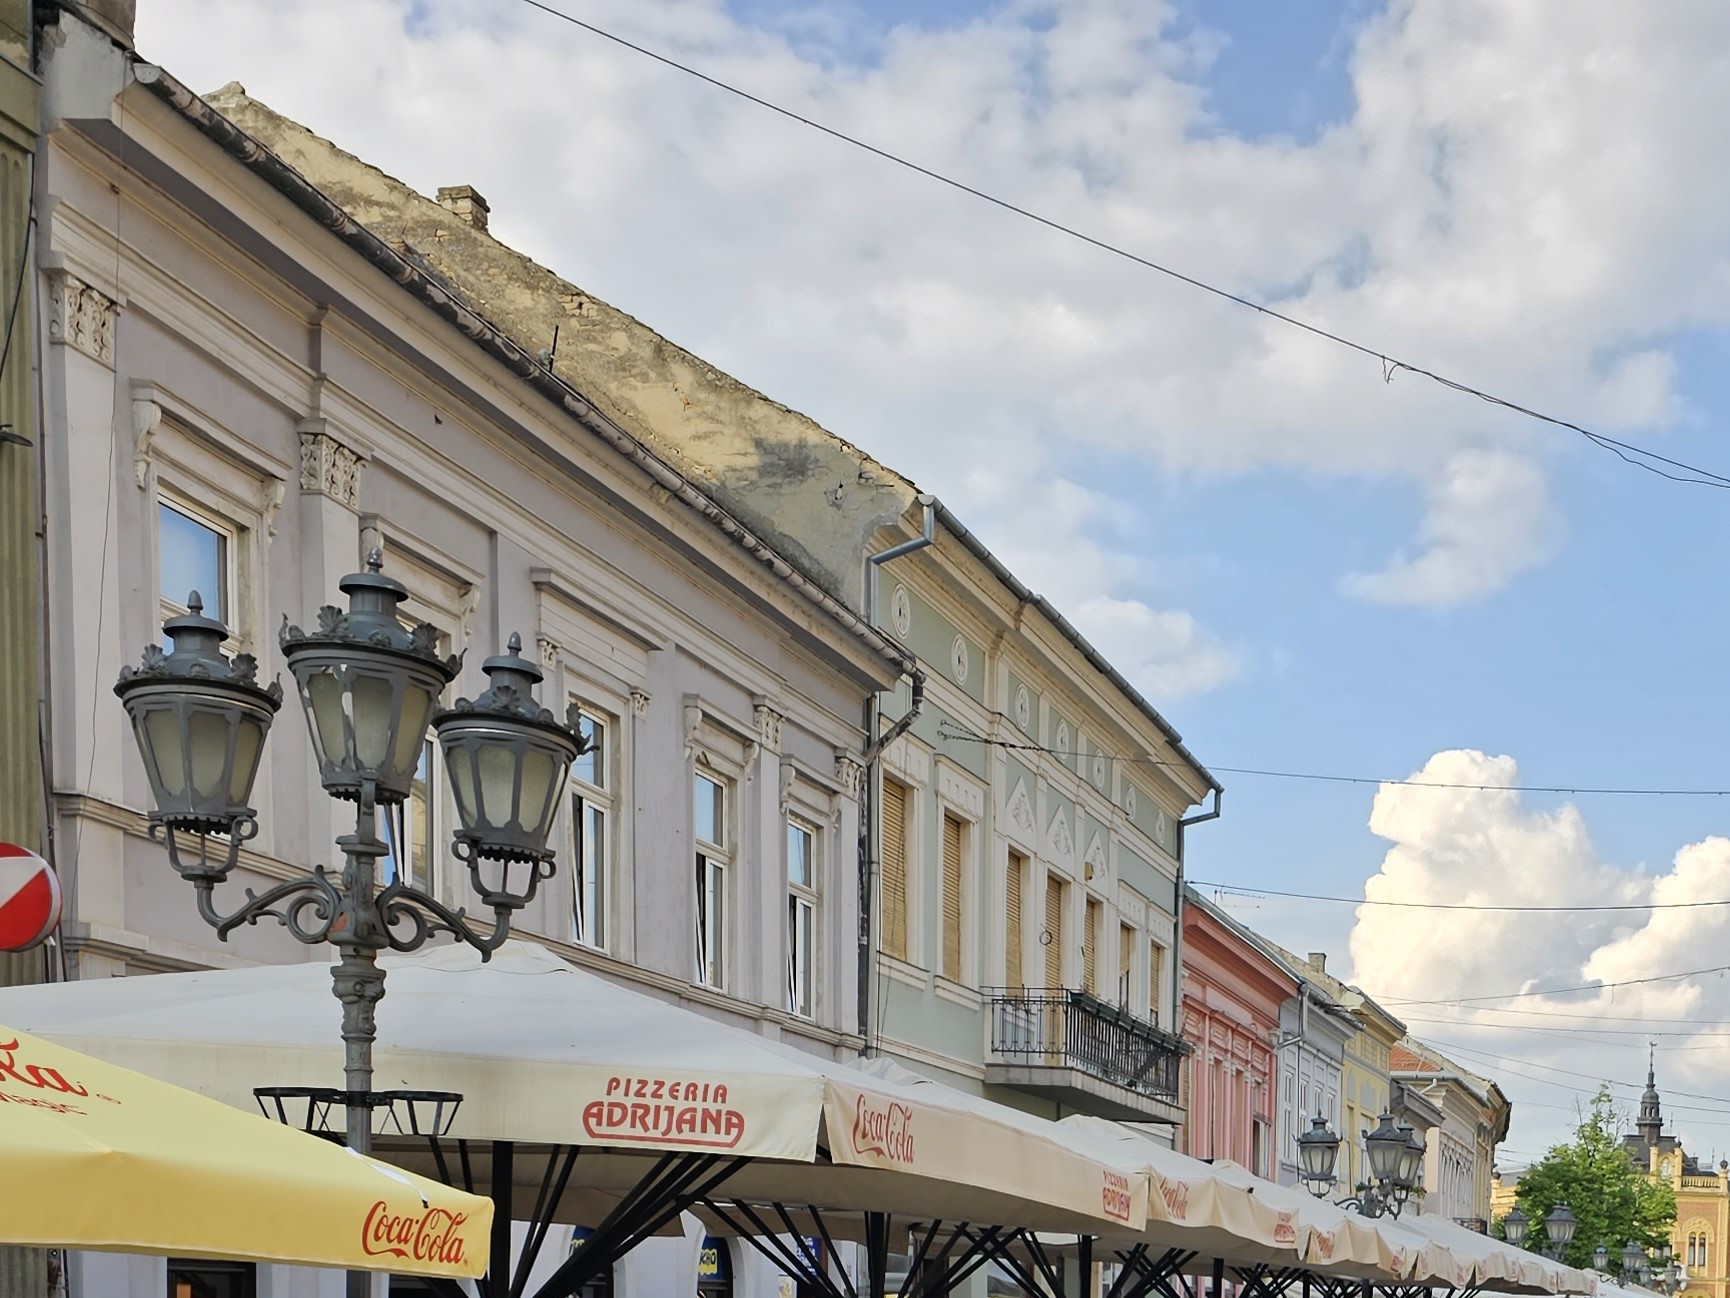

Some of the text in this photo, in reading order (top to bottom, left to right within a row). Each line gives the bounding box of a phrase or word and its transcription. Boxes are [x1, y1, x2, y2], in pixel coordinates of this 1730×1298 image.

[605, 1076, 728, 1104] PIZZERIA
[581, 1100, 745, 1145] ADRIJANA
[853, 1093, 916, 1164] Coca-Cola
[362, 1200, 466, 1265] Coca-Cola
